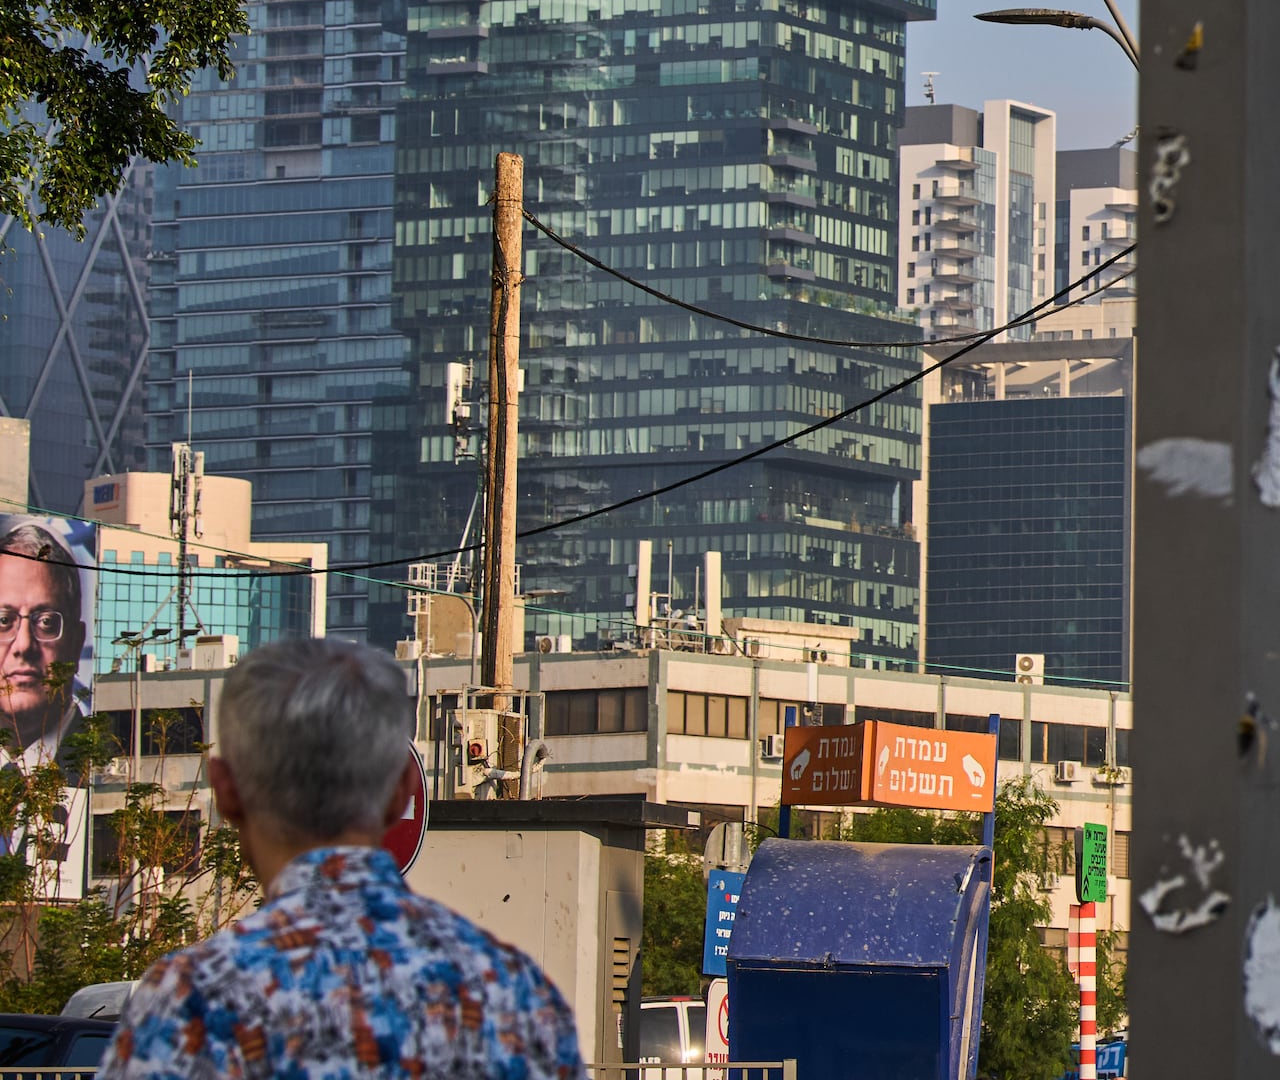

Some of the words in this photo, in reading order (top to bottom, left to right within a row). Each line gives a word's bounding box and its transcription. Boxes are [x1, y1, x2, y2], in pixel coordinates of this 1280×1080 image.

[817, 735, 857, 759] עמדת
[894, 736, 948, 763] עמדת
[889, 767, 954, 797] תשלום
